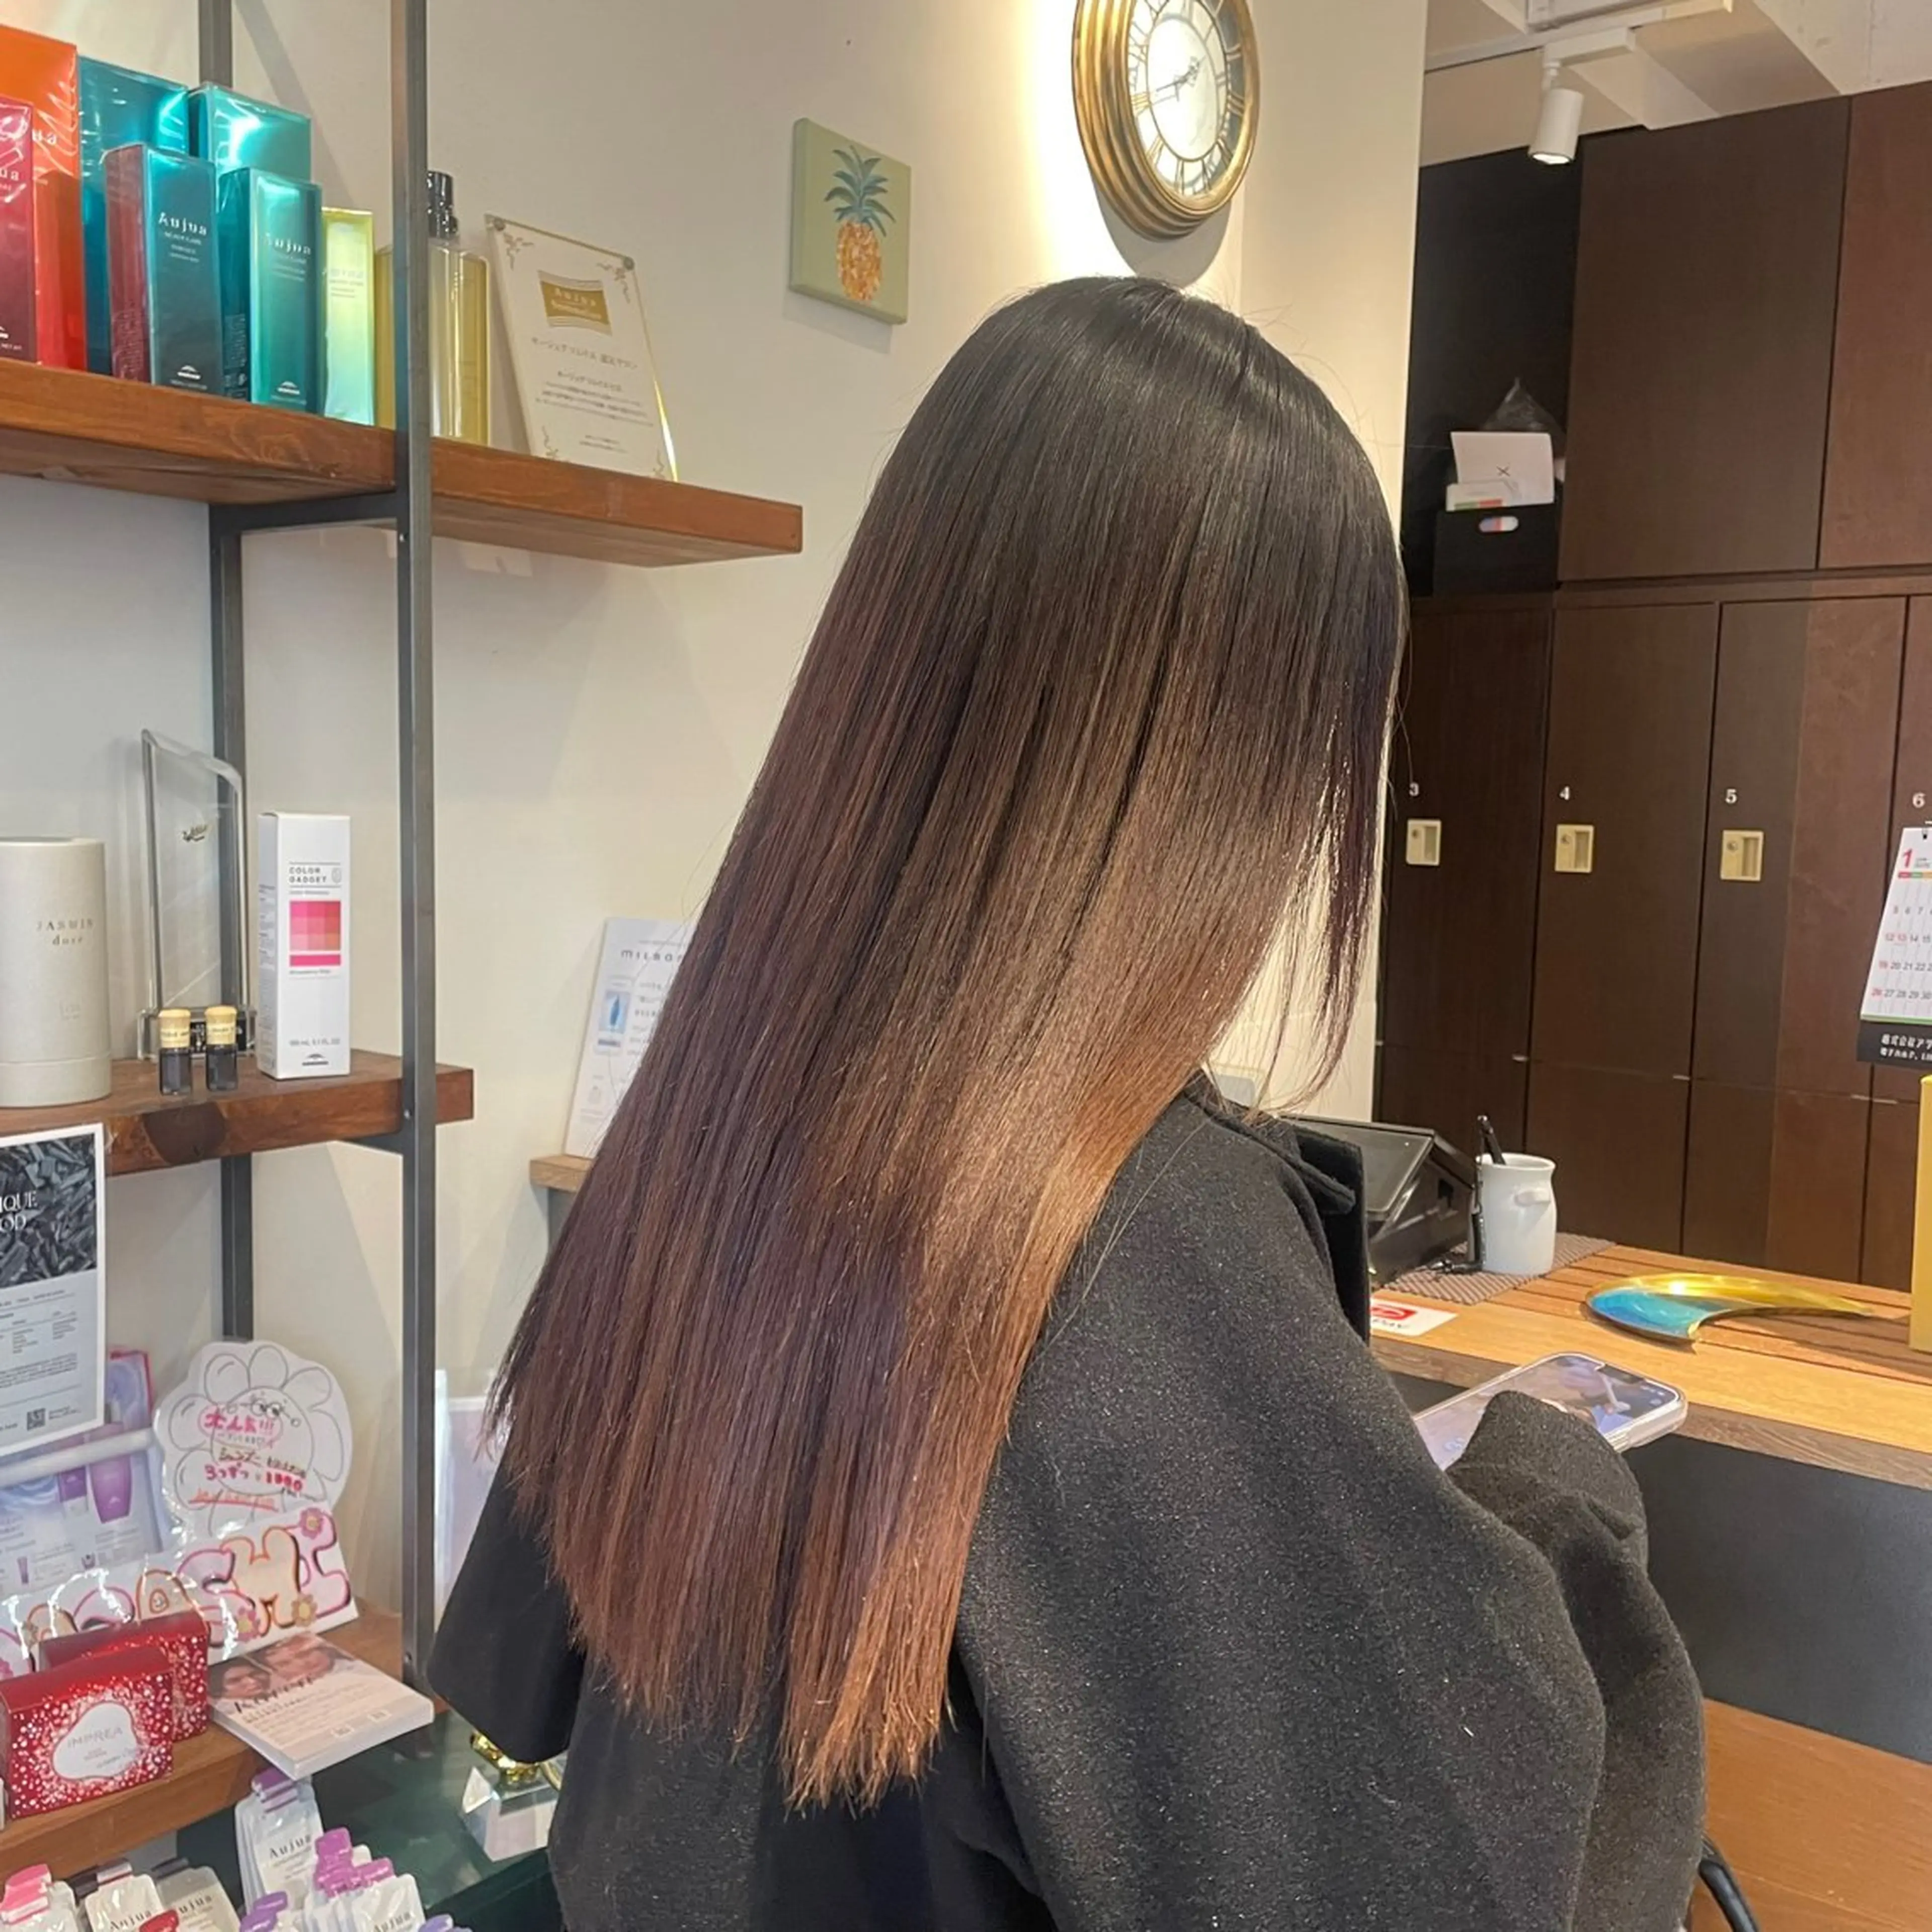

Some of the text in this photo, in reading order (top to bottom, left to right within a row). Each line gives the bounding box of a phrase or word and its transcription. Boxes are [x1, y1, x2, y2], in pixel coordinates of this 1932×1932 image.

[158, 212, 207, 235] Aujua
[1409, 782, 1419, 796] 3
[1560, 786, 1570, 800] 4
[1726, 789, 1737, 803] 5
[1912, 792, 1926, 808] 6
[1902, 848, 1912, 867] 1
[289, 866, 321, 874] COLOR
[269, 1834, 311, 1859] Aujua
[179, 1895, 212, 1914] ujua
